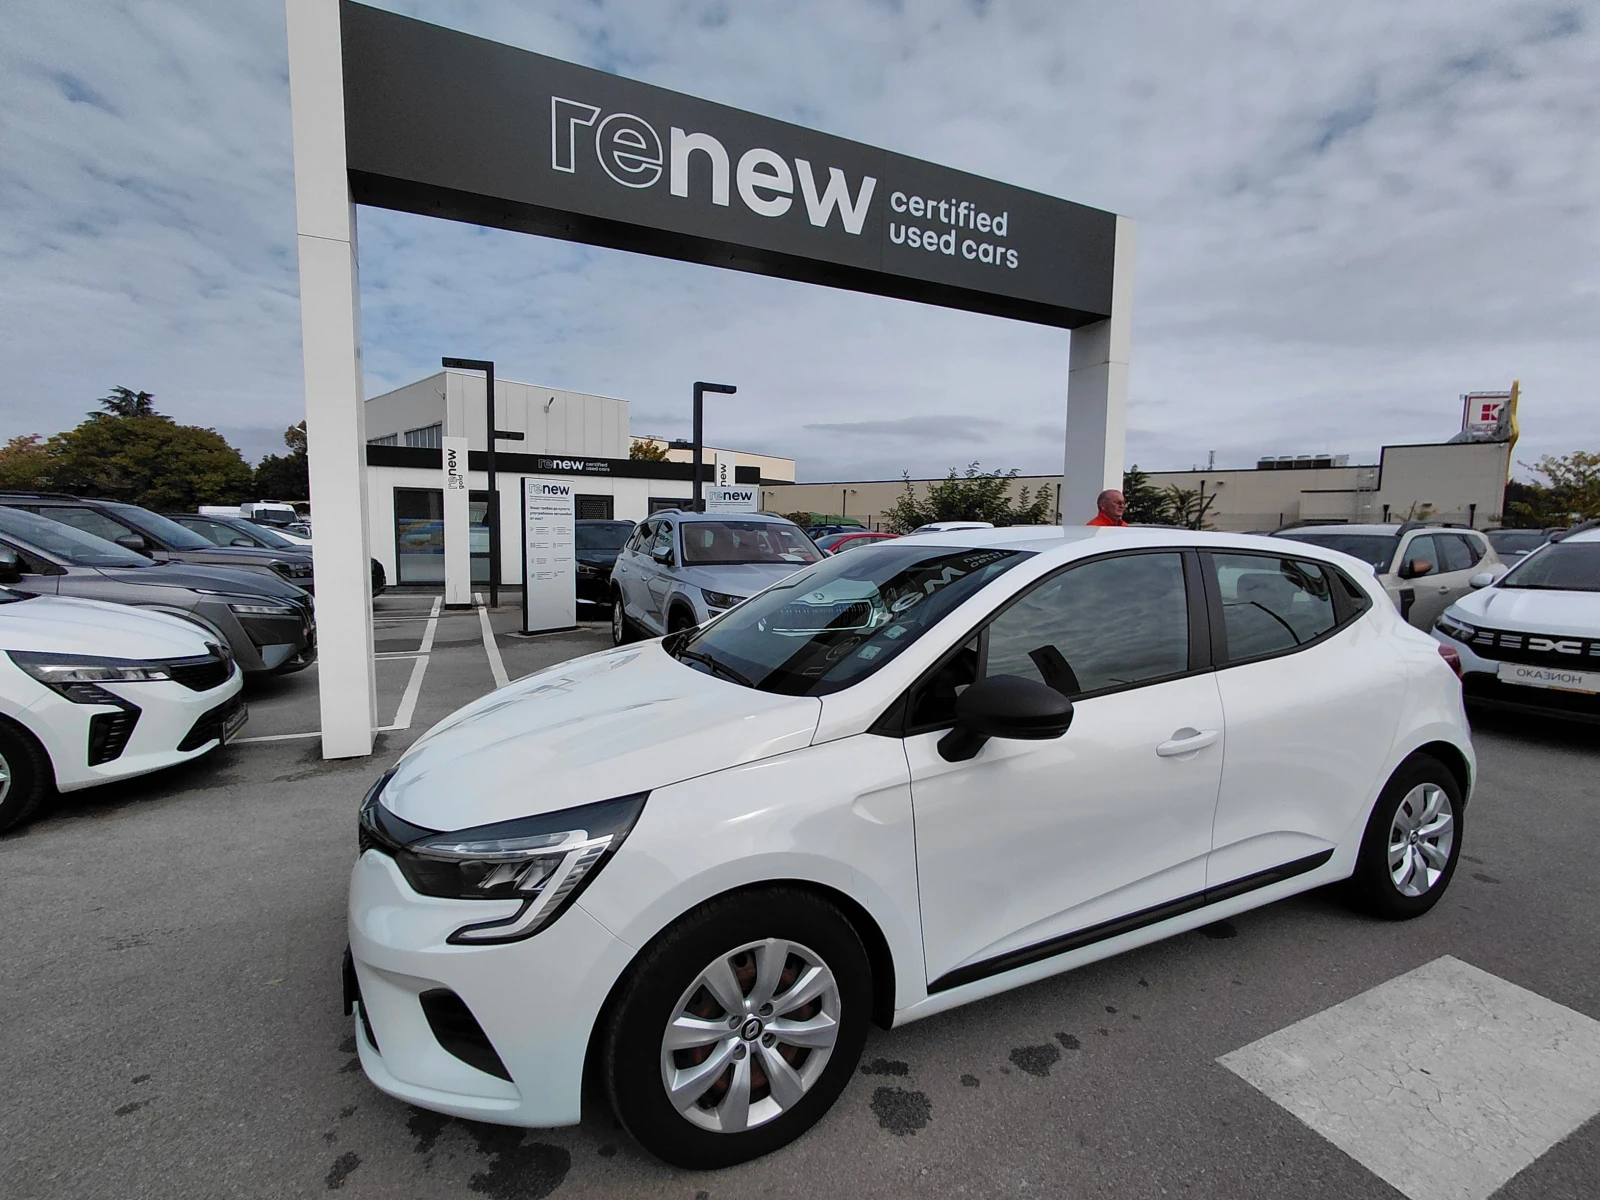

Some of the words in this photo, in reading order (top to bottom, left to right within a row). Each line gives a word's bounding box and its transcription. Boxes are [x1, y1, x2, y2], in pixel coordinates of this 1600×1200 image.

[550, 95, 877, 236] renew
[890, 190, 1009, 238] certified
[889, 222, 957, 256] used
[961, 239, 1020, 269] cars
[448, 449, 458, 490] renew
[538, 459, 584, 471] renew
[457, 474, 465, 490] gold
[529, 484, 570, 495] renew
[709, 491, 753, 501] renew
[1516, 668, 1583, 684] ОКАЗИОН
